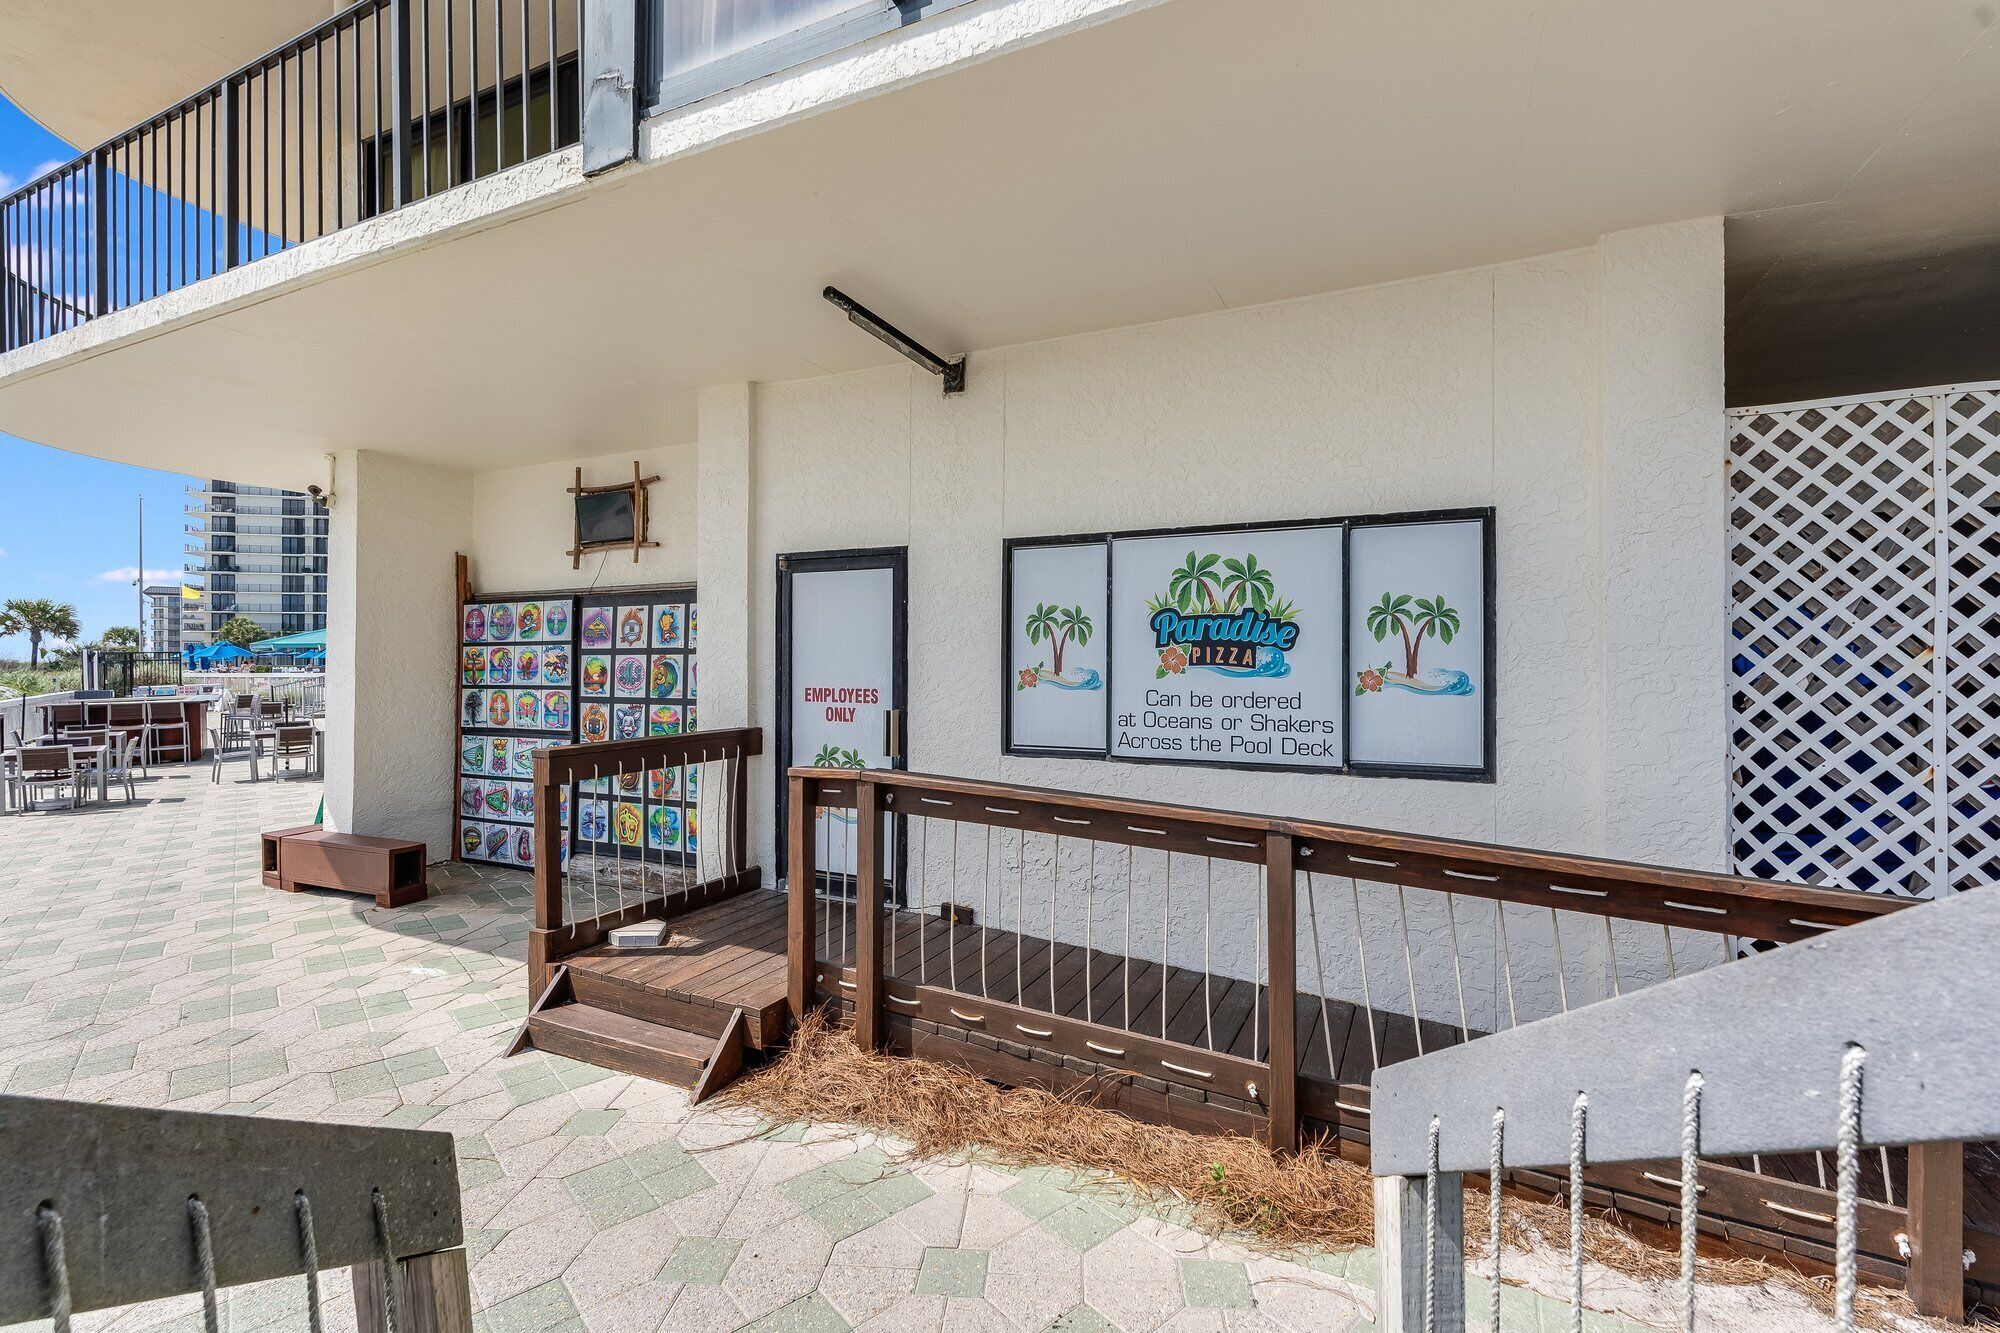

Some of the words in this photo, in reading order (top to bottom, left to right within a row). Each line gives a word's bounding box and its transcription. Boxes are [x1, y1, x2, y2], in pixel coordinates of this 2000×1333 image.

[1154, 611, 1297, 648] Paradise
[1192, 646, 1253, 666] PIZZA
[804, 687, 879, 705] EMPLOYEES
[1146, 689, 1181, 707] Can
[1190, 690, 1213, 708] be
[1221, 691, 1302, 710] ordered
[825, 706, 856, 723] ONLY
[1118, 712, 1137, 728] at
[1143, 710, 1213, 730] Oceans
[1221, 717, 1243, 731] or
[1250, 713, 1334, 734] Shakers
[1117, 731, 1183, 751] Across
[1189, 734, 1222, 752] the
[1230, 735, 1272, 755] Pool
[1281, 737, 1335, 757] Deck
